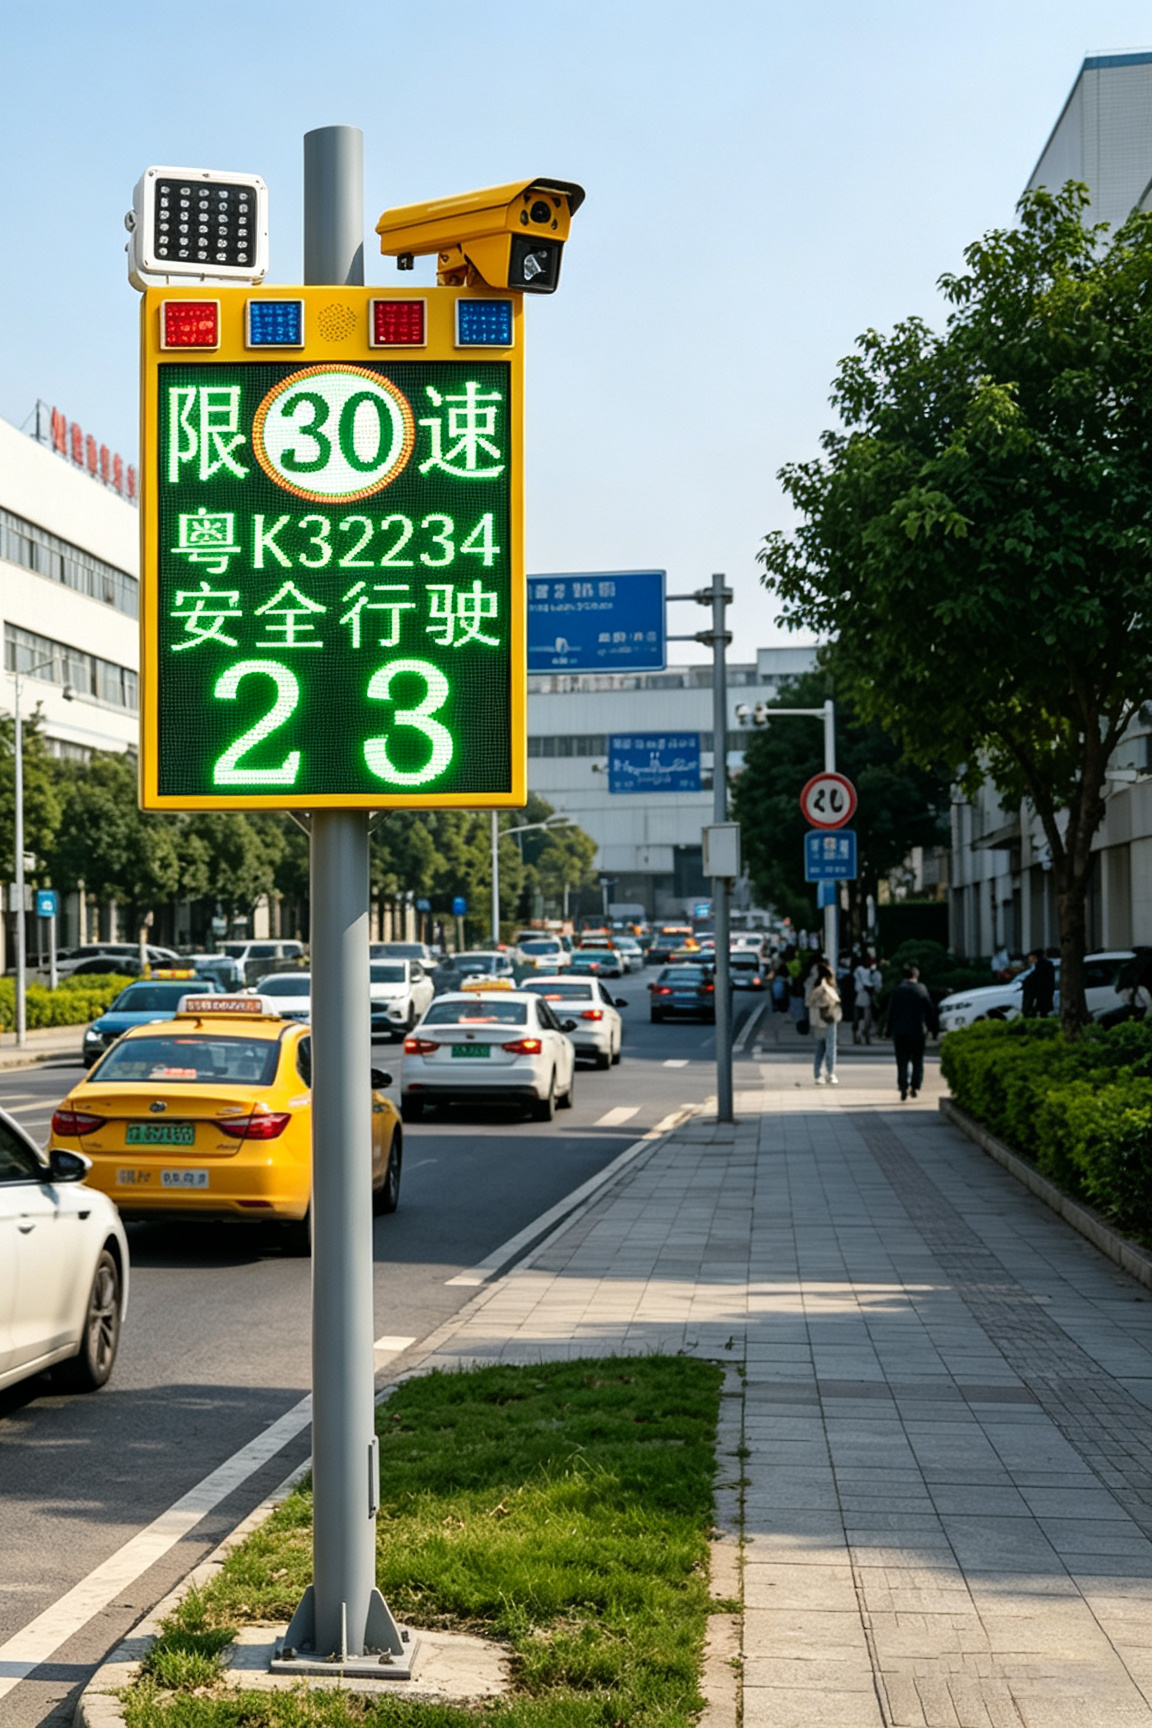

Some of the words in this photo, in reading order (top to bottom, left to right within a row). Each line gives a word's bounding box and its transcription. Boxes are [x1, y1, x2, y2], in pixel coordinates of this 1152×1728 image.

[168, 385, 249, 482] 限
[279, 391, 395, 473] 30
[418, 381, 506, 479] 速
[170, 507, 501, 574] 粤K32234
[170, 580, 501, 651] 安全行驶
